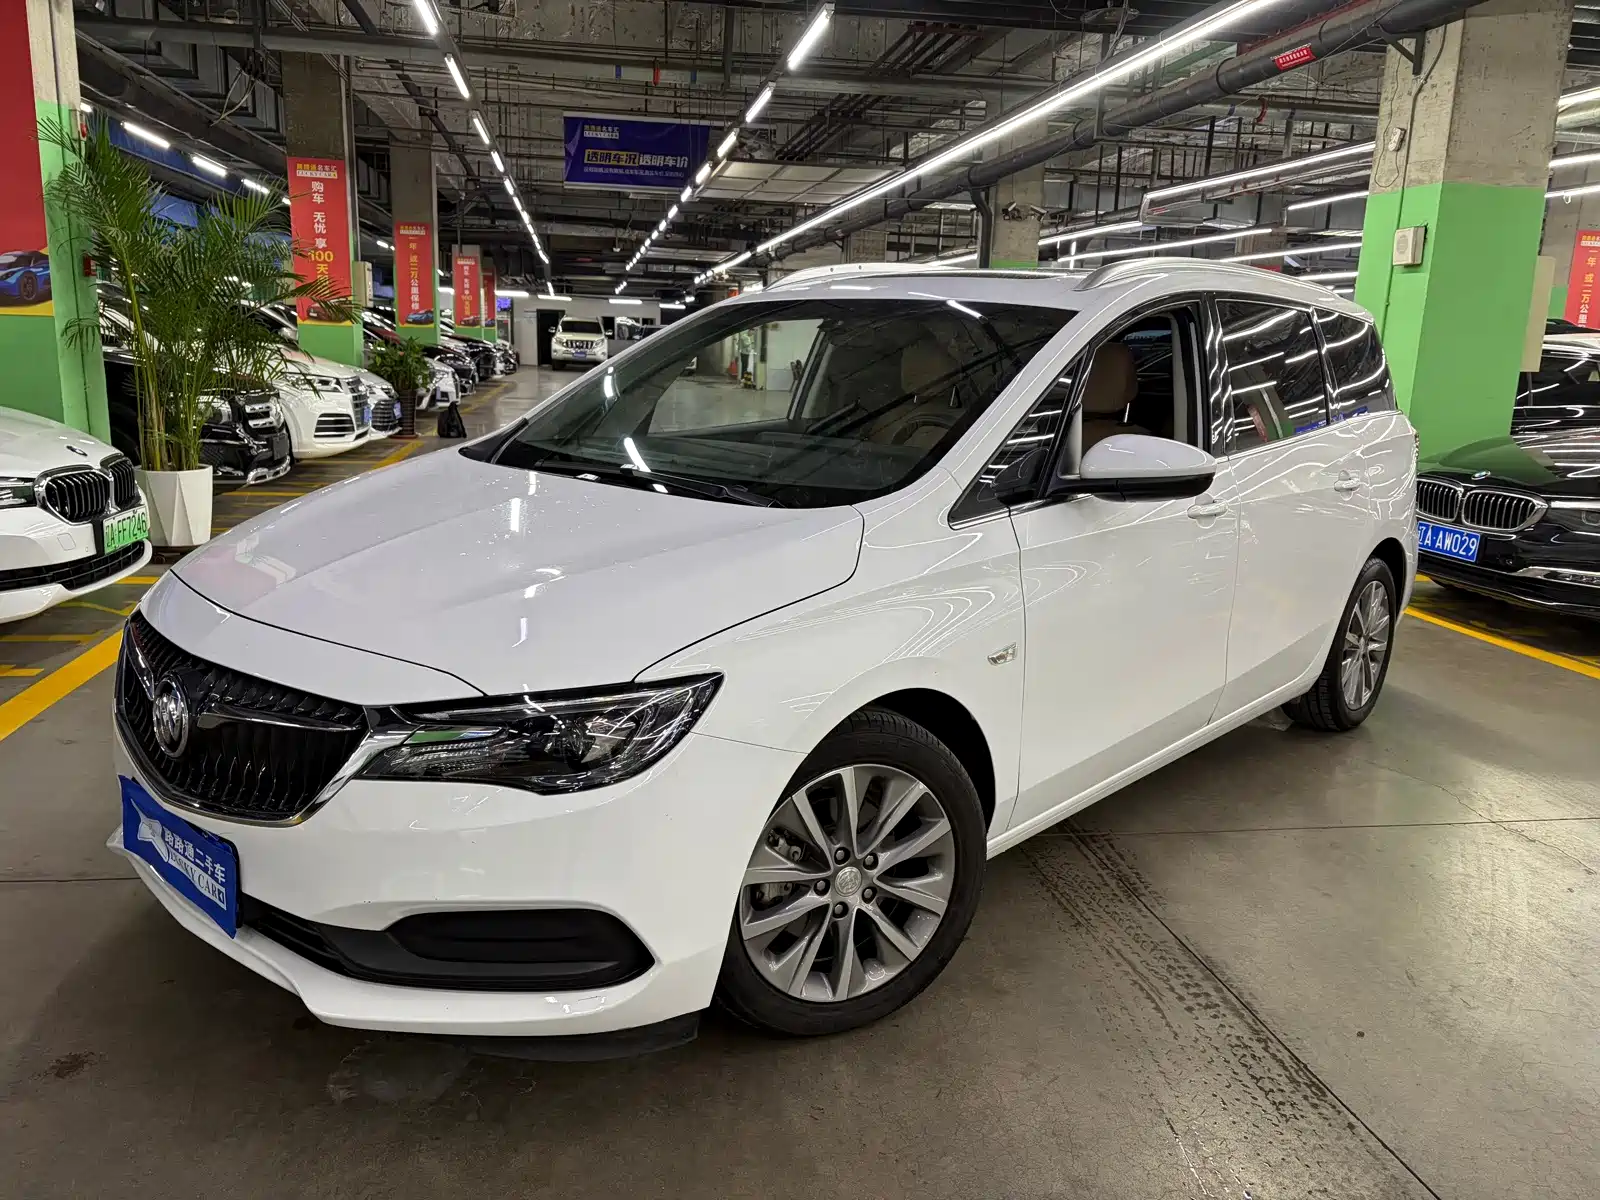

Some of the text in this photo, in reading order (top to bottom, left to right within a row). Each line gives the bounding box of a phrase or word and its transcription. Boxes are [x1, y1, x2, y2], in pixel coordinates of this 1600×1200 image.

[587, 151, 688, 168] 透明车况 透明车价
